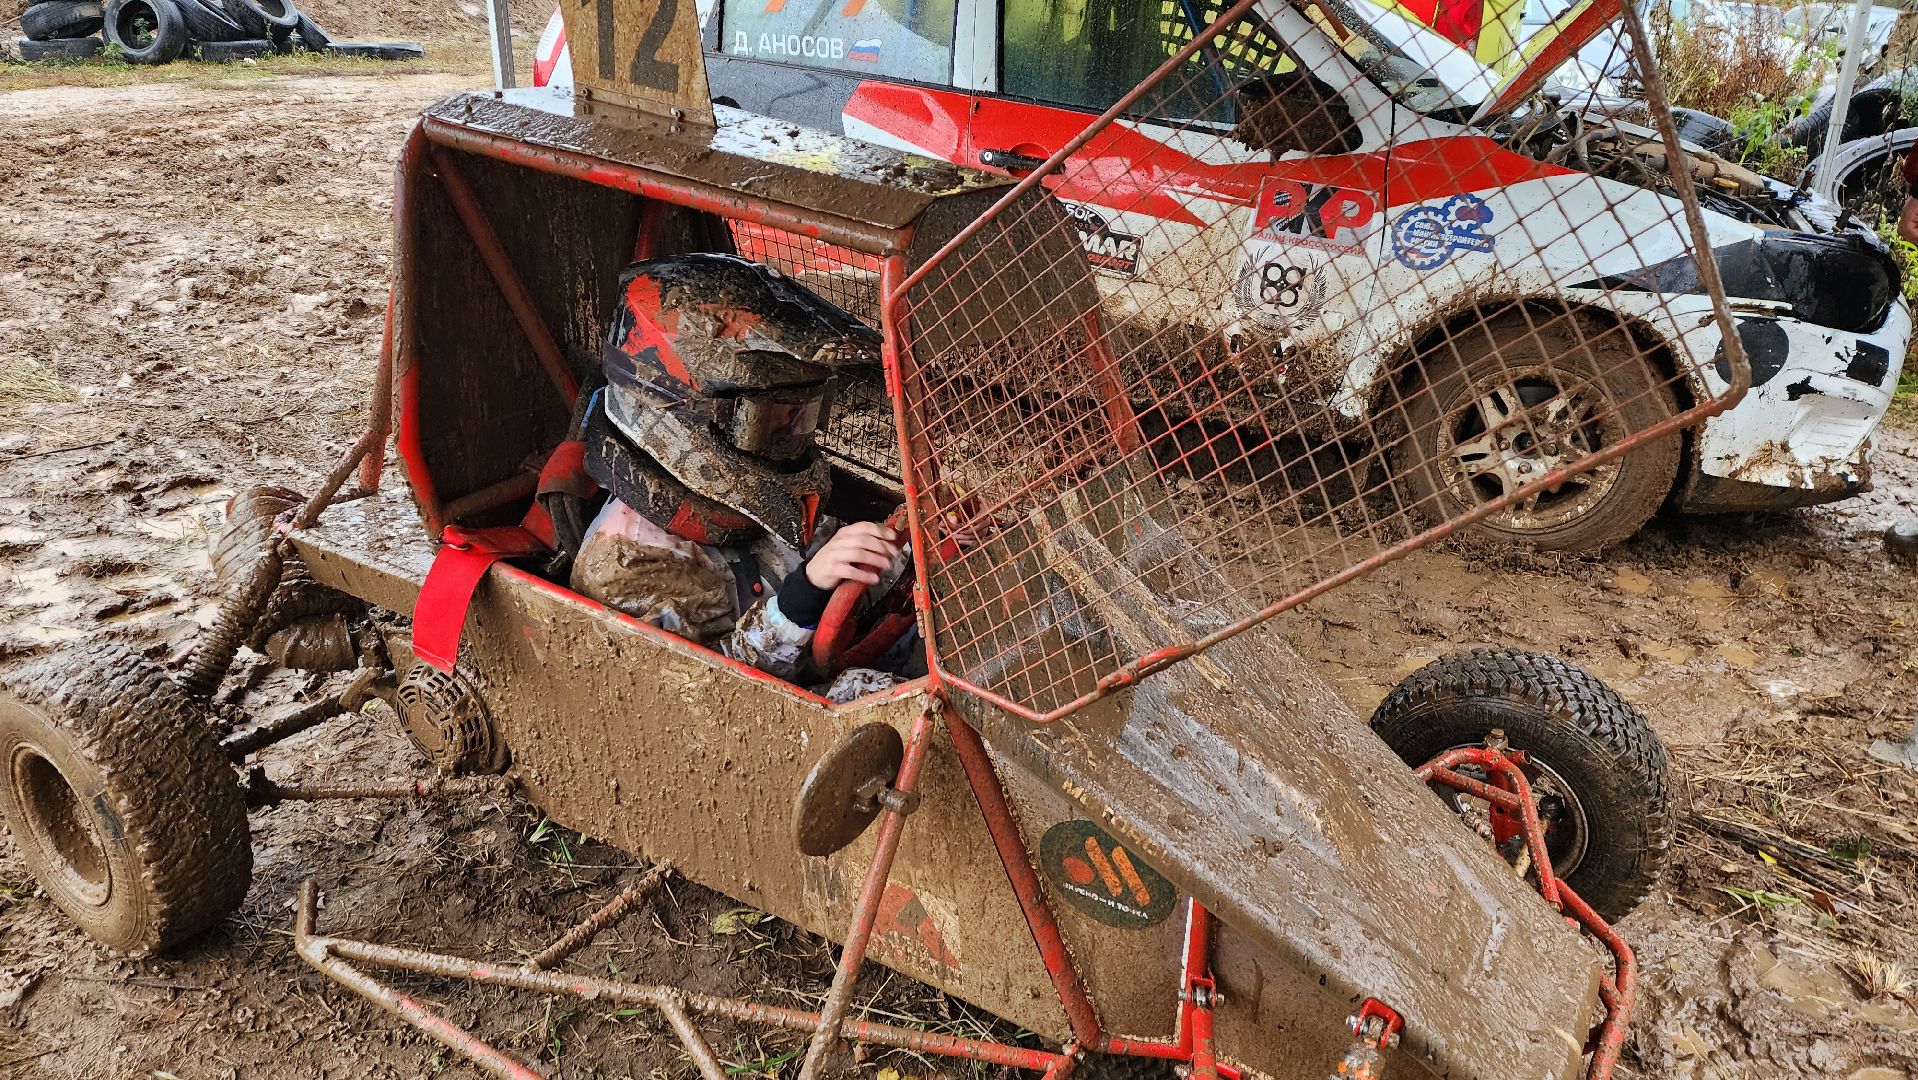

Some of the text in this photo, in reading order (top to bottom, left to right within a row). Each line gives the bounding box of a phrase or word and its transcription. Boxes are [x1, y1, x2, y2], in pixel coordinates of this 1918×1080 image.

[581, 0, 680, 94] 12
[733, 30, 844, 59] Д. АНОСОВ
[1078, 229, 1138, 261] MAR
